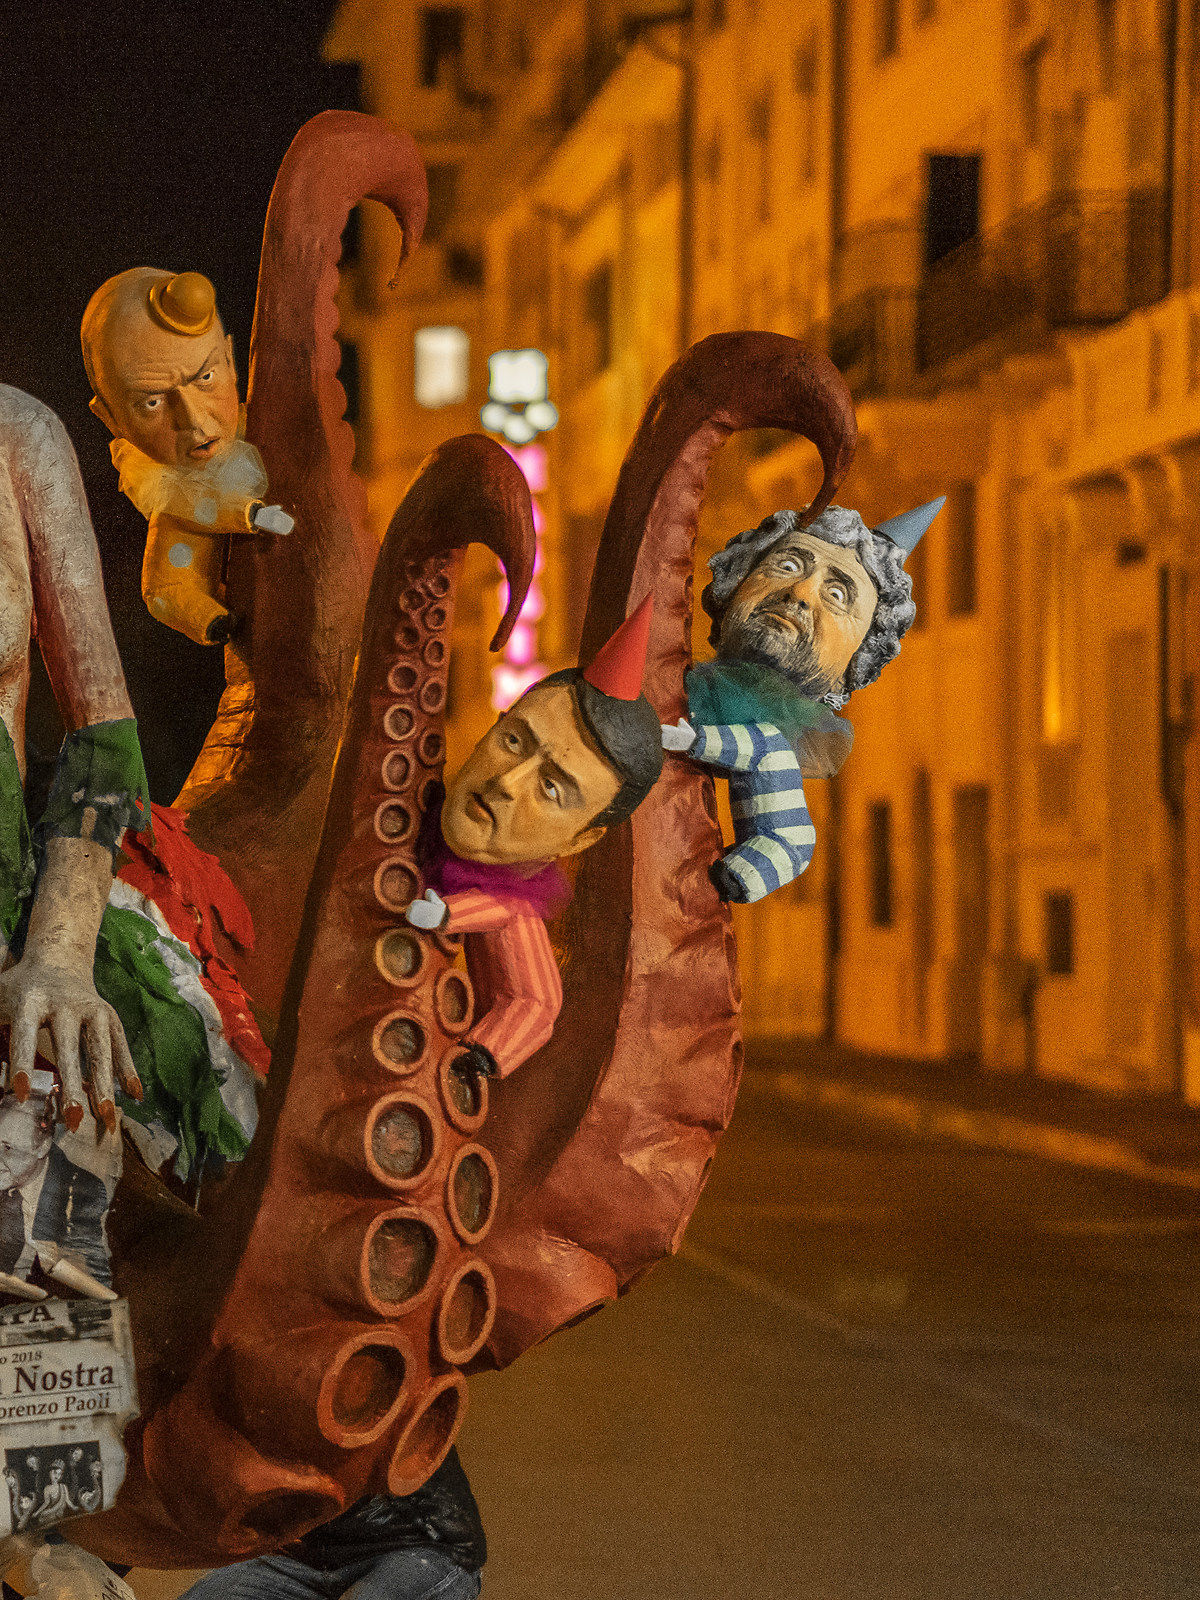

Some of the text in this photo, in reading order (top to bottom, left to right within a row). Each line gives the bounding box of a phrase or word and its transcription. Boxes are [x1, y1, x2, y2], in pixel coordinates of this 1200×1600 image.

[11, 1350, 43, 1364] 2018
[13, 1362, 114, 1393] Nostra
[64, 1391, 110, 1412] Paoli
